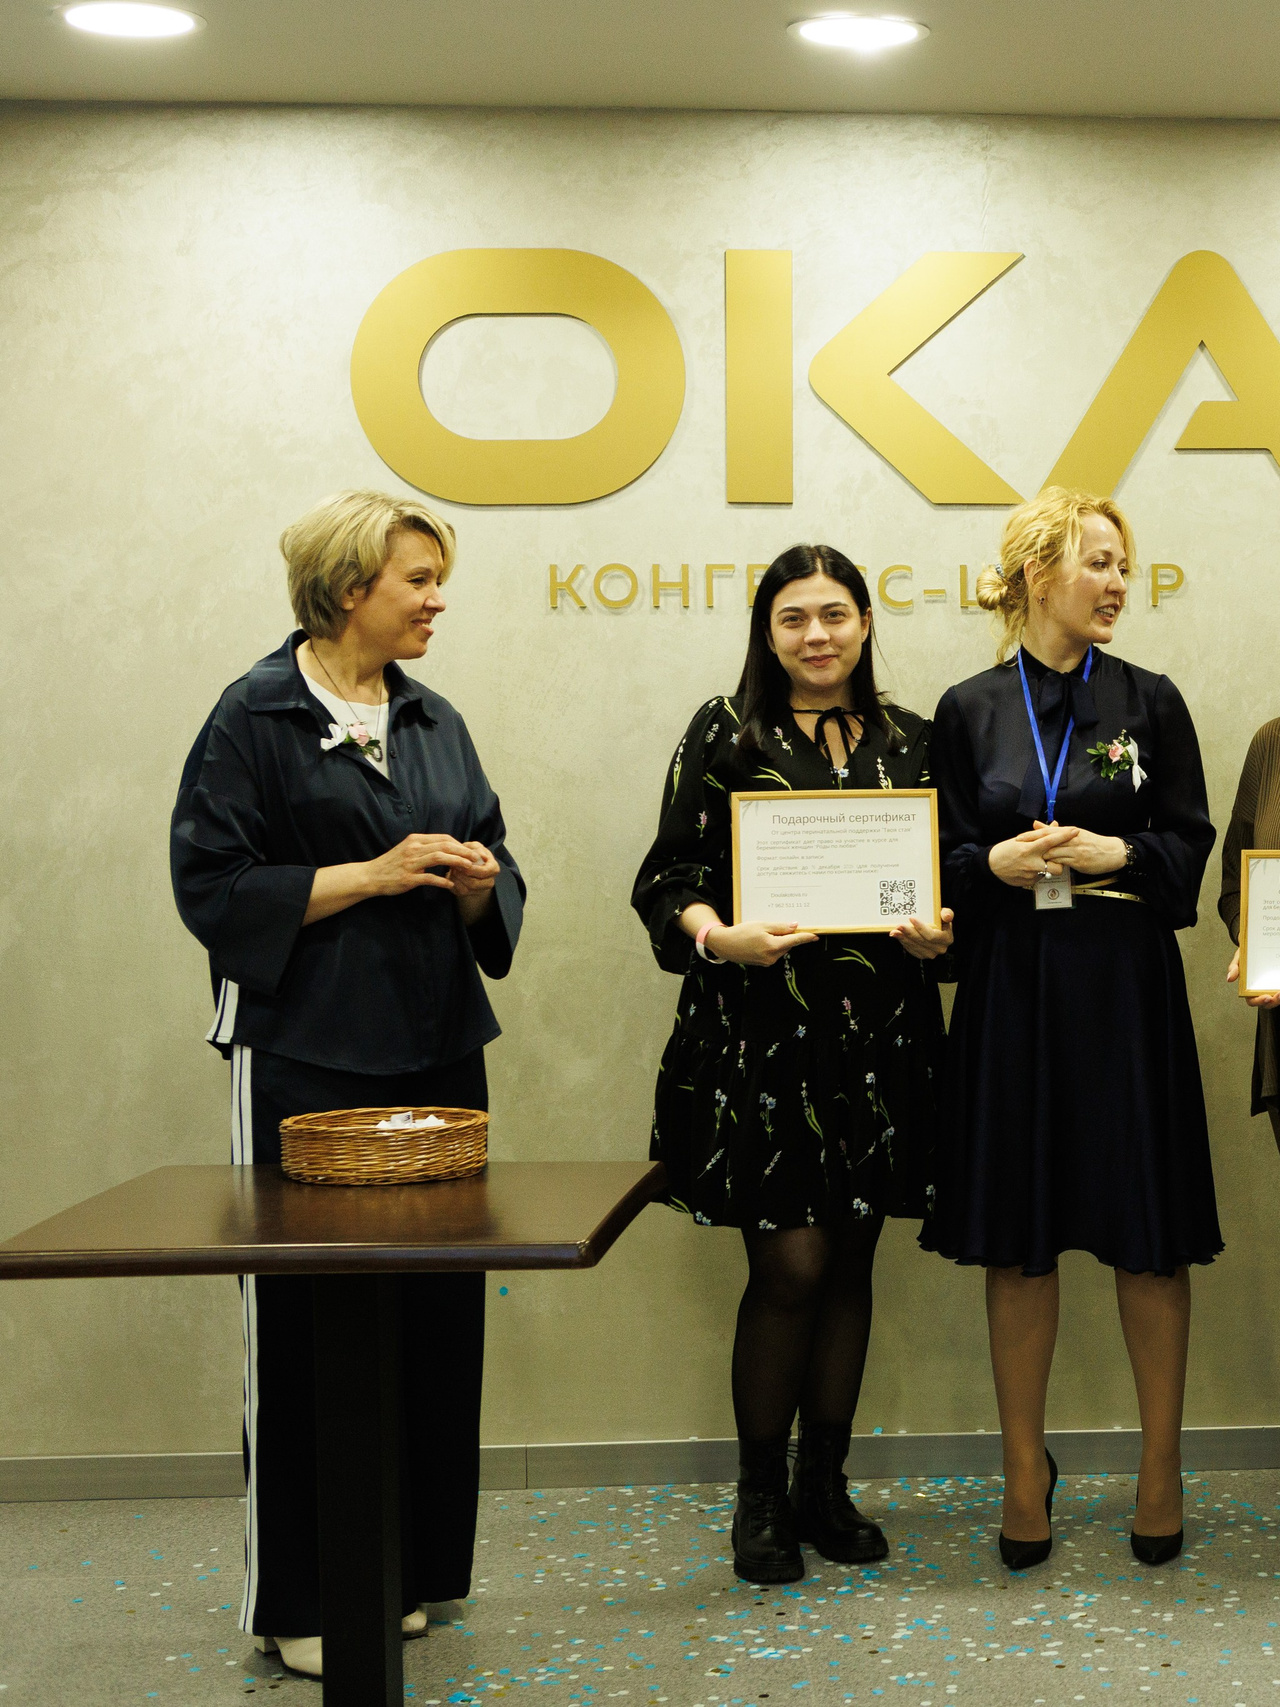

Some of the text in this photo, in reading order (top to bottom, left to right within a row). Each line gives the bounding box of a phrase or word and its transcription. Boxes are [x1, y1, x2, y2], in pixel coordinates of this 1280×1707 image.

[549, 563, 1186, 609] КОНГРС-ЦР
[772, 812, 916, 826] Подарочный сертификат
